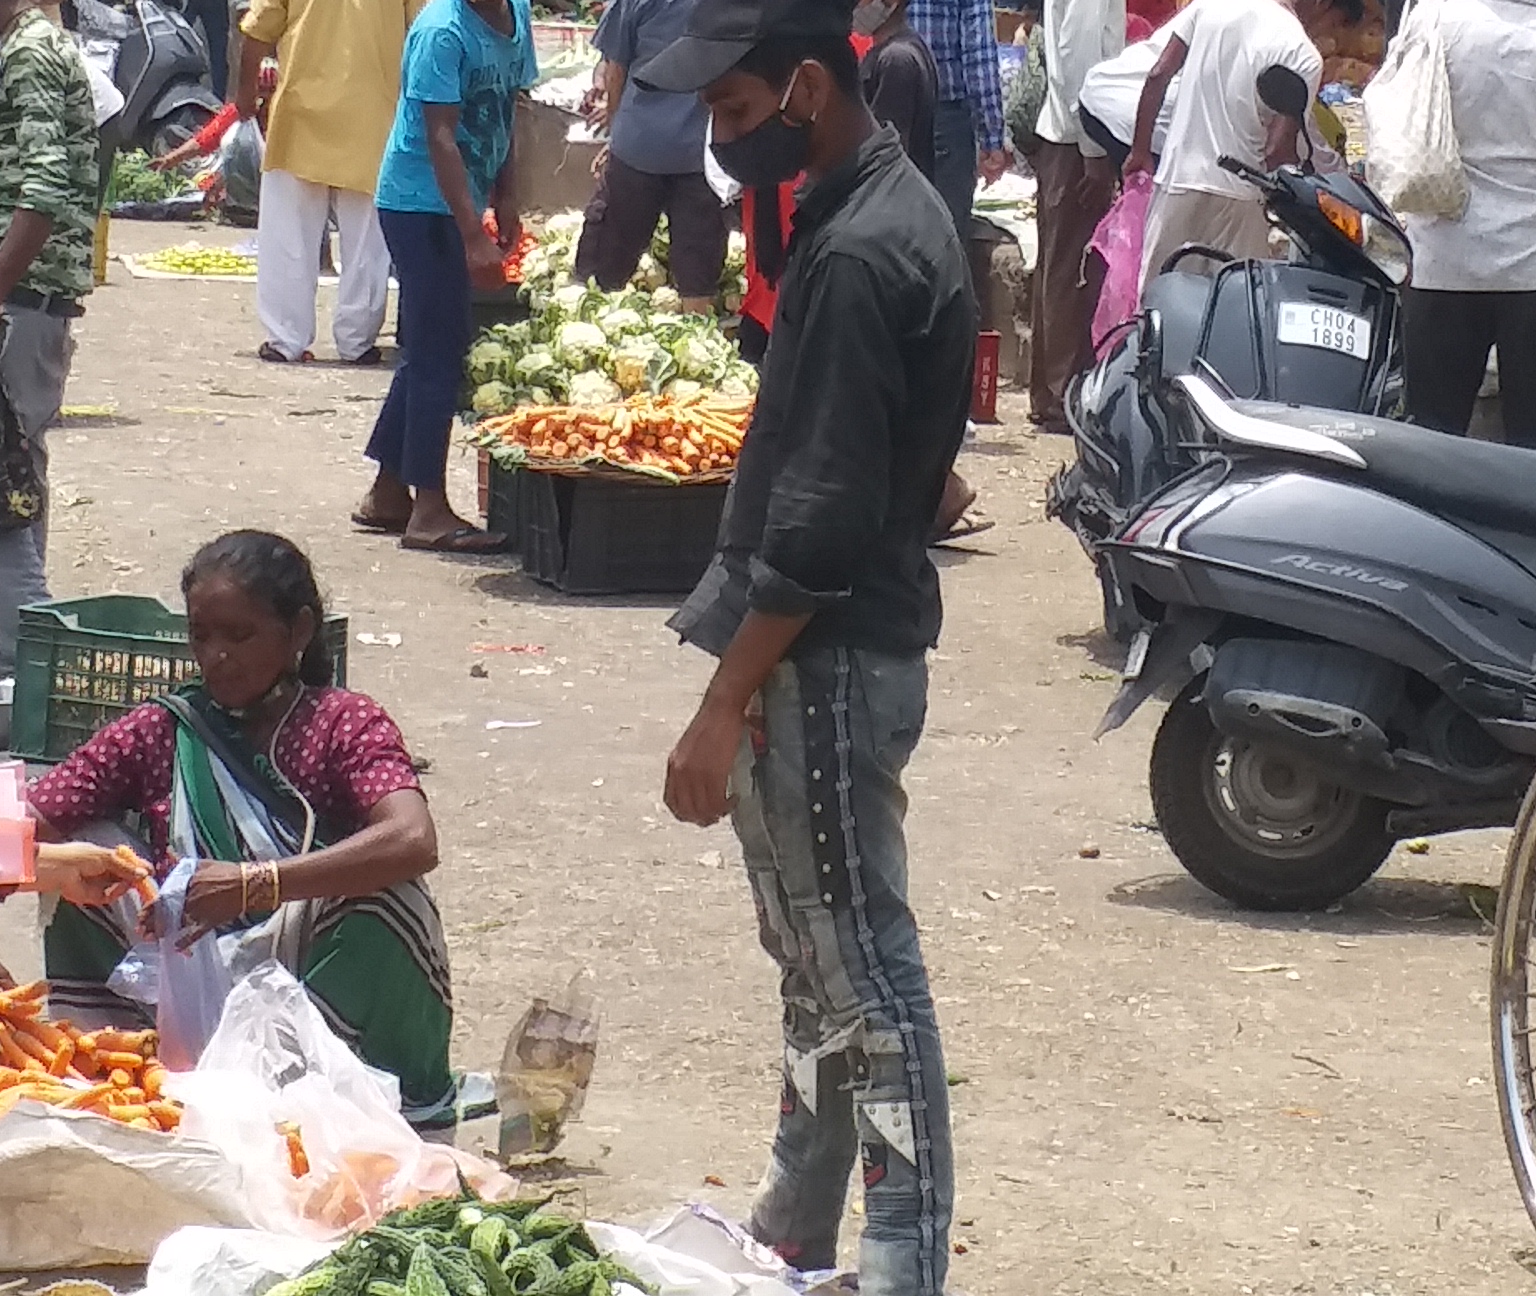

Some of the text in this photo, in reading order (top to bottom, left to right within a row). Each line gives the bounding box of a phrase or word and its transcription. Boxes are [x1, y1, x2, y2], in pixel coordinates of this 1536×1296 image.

[1311, 308, 1355, 333] CH04
[1312, 327, 1355, 352] 1899
[1270, 554, 1409, 593] Activa
